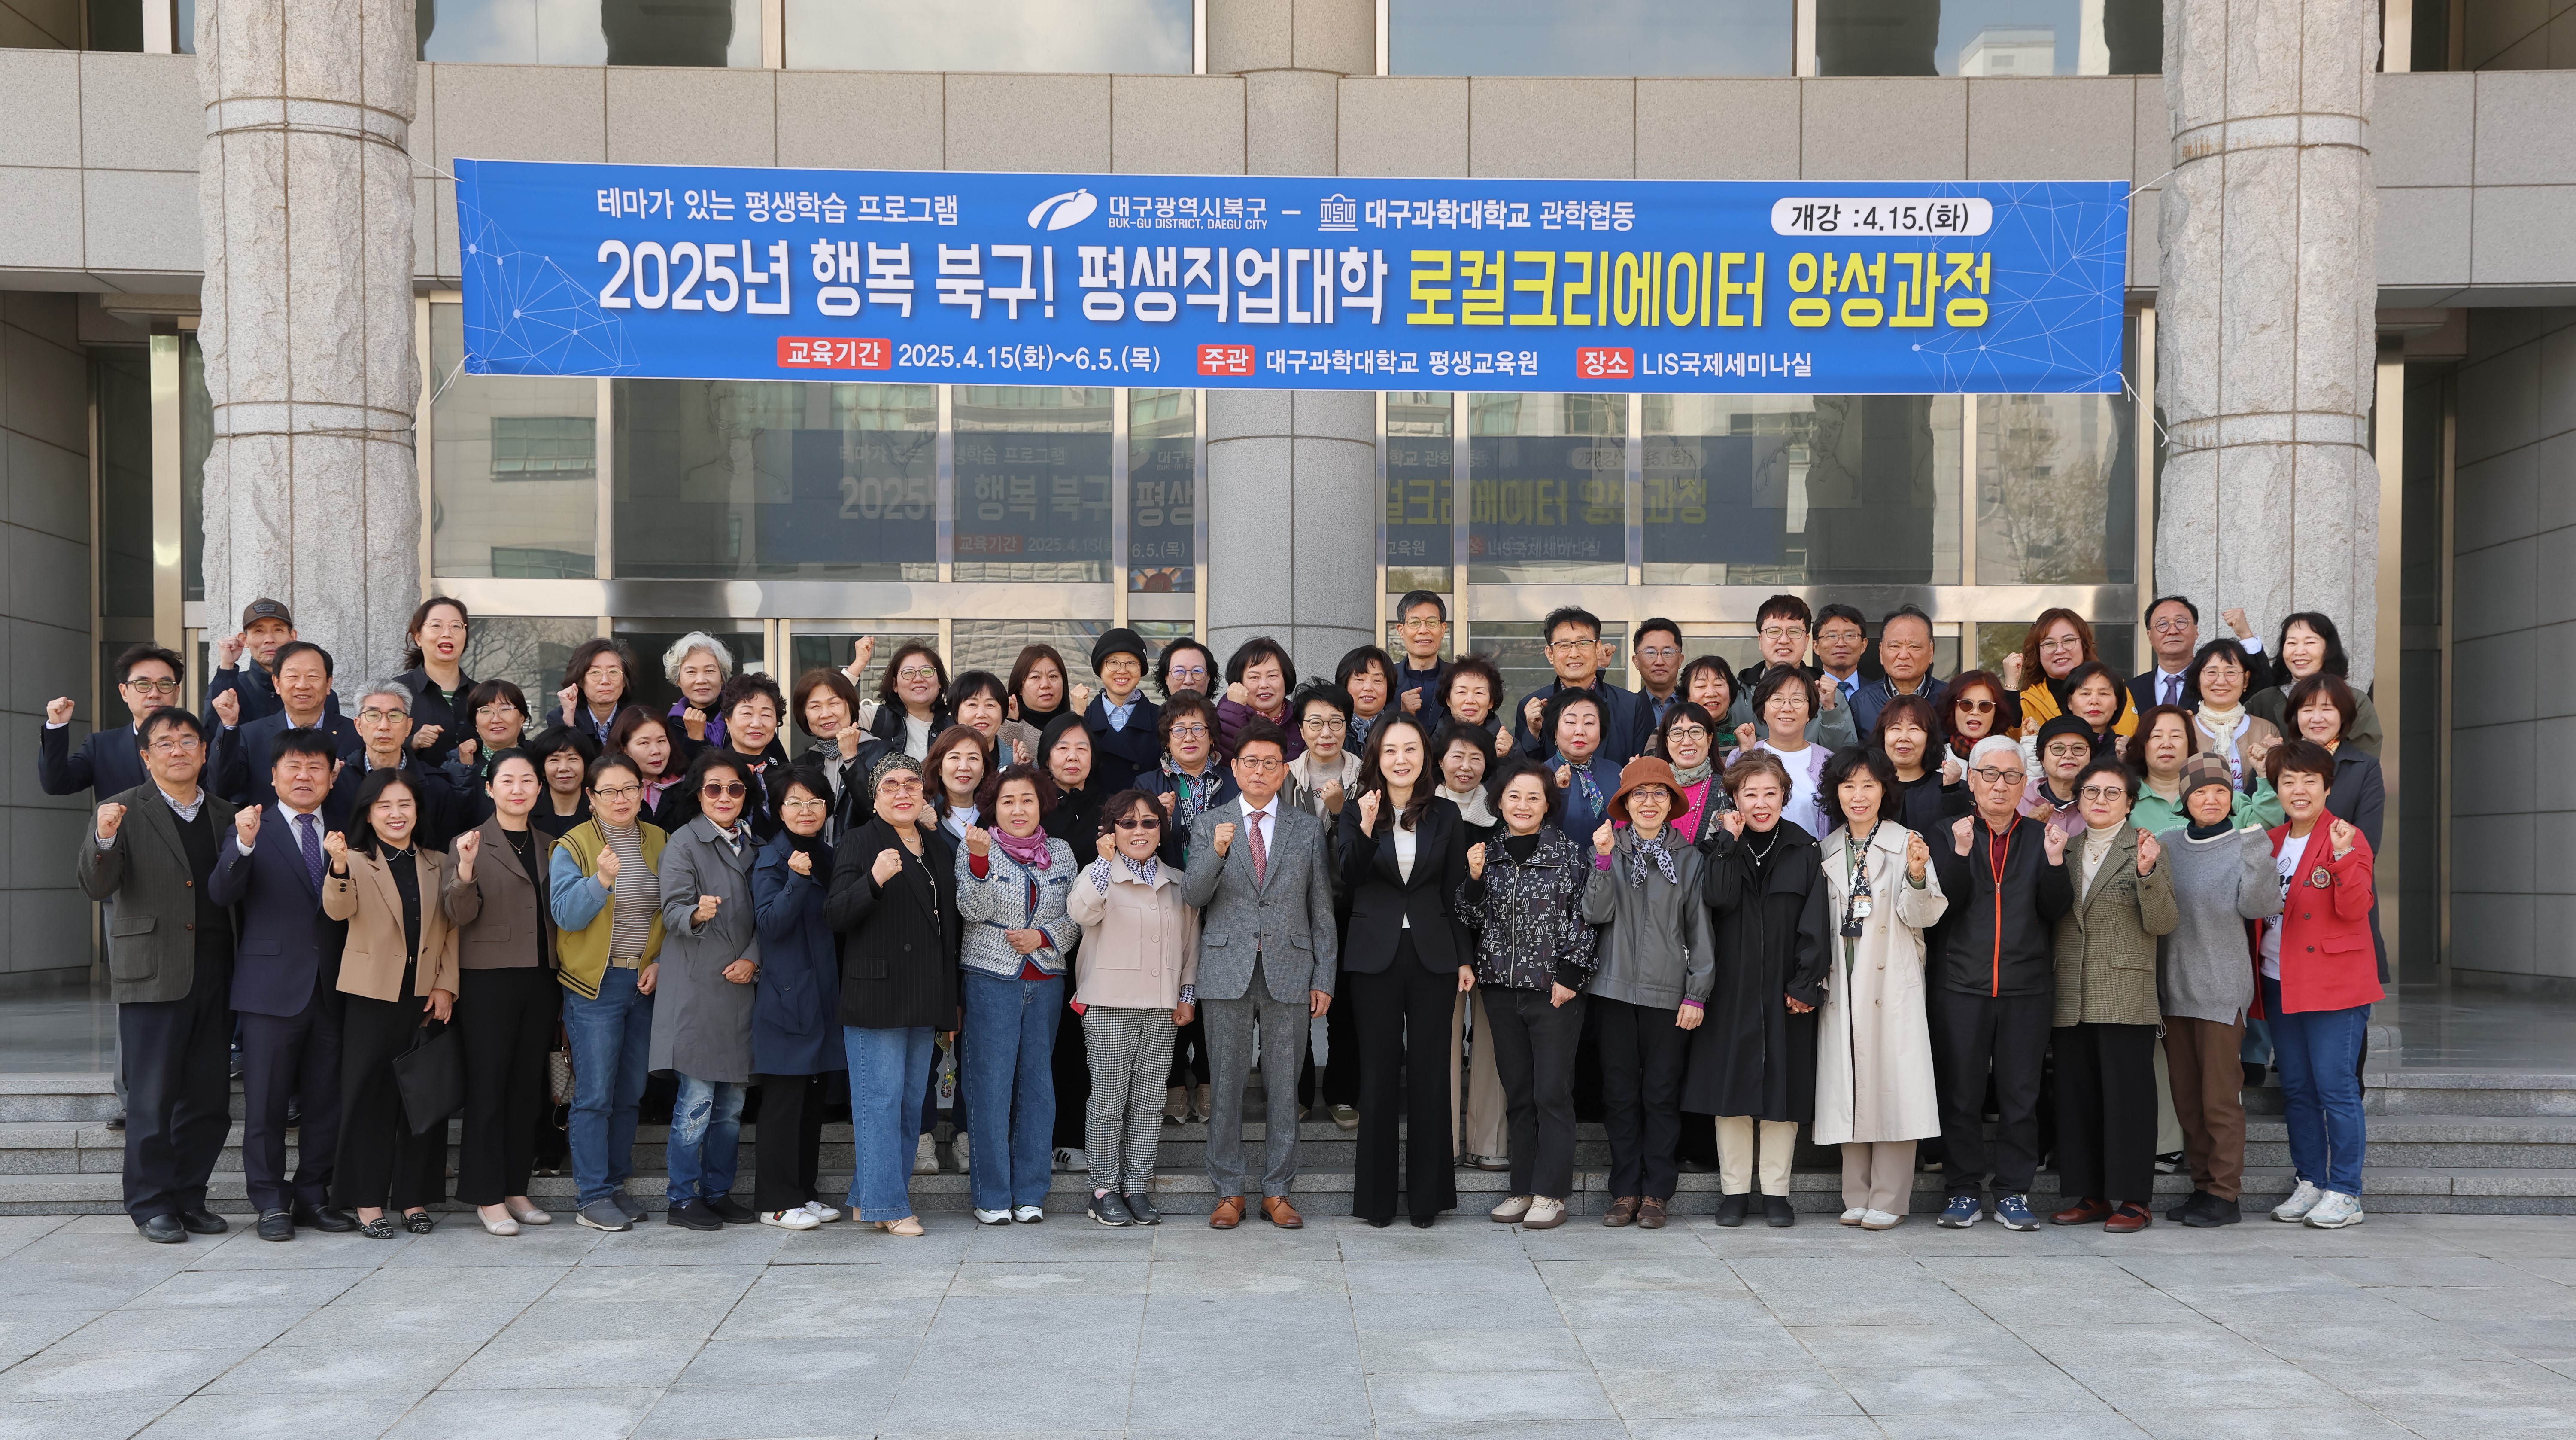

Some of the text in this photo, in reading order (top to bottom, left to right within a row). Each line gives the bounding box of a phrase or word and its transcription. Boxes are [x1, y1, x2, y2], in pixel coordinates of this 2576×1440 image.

[597, 188, 957, 225] 테마가 있는 평생학습 프로그램
[1109, 196, 1267, 219] 대구광역시북구
[1365, 199, 1635, 231] 대구과학대학교 관학협동
[1791, 204, 1841, 231] 개강
[1109, 217, 1268, 230] BUK-GU DISTRICT, DAEGU CITY
[598, 238, 1991, 328] 2025년 행복 북구! 평생직업대학 로컬크리에이터 양성과정
[787, 341, 1160, 373] 교육기간 2025.4.15(화)~6.5.(목)
[1203, 348, 1537, 376] 주관 대구과학대학교 평생교육원
[1584, 351, 1811, 377] 장소 LIS국제세미나실
[974, 473, 1038, 521] 행복
[959, 535, 1017, 553] 교육기간
